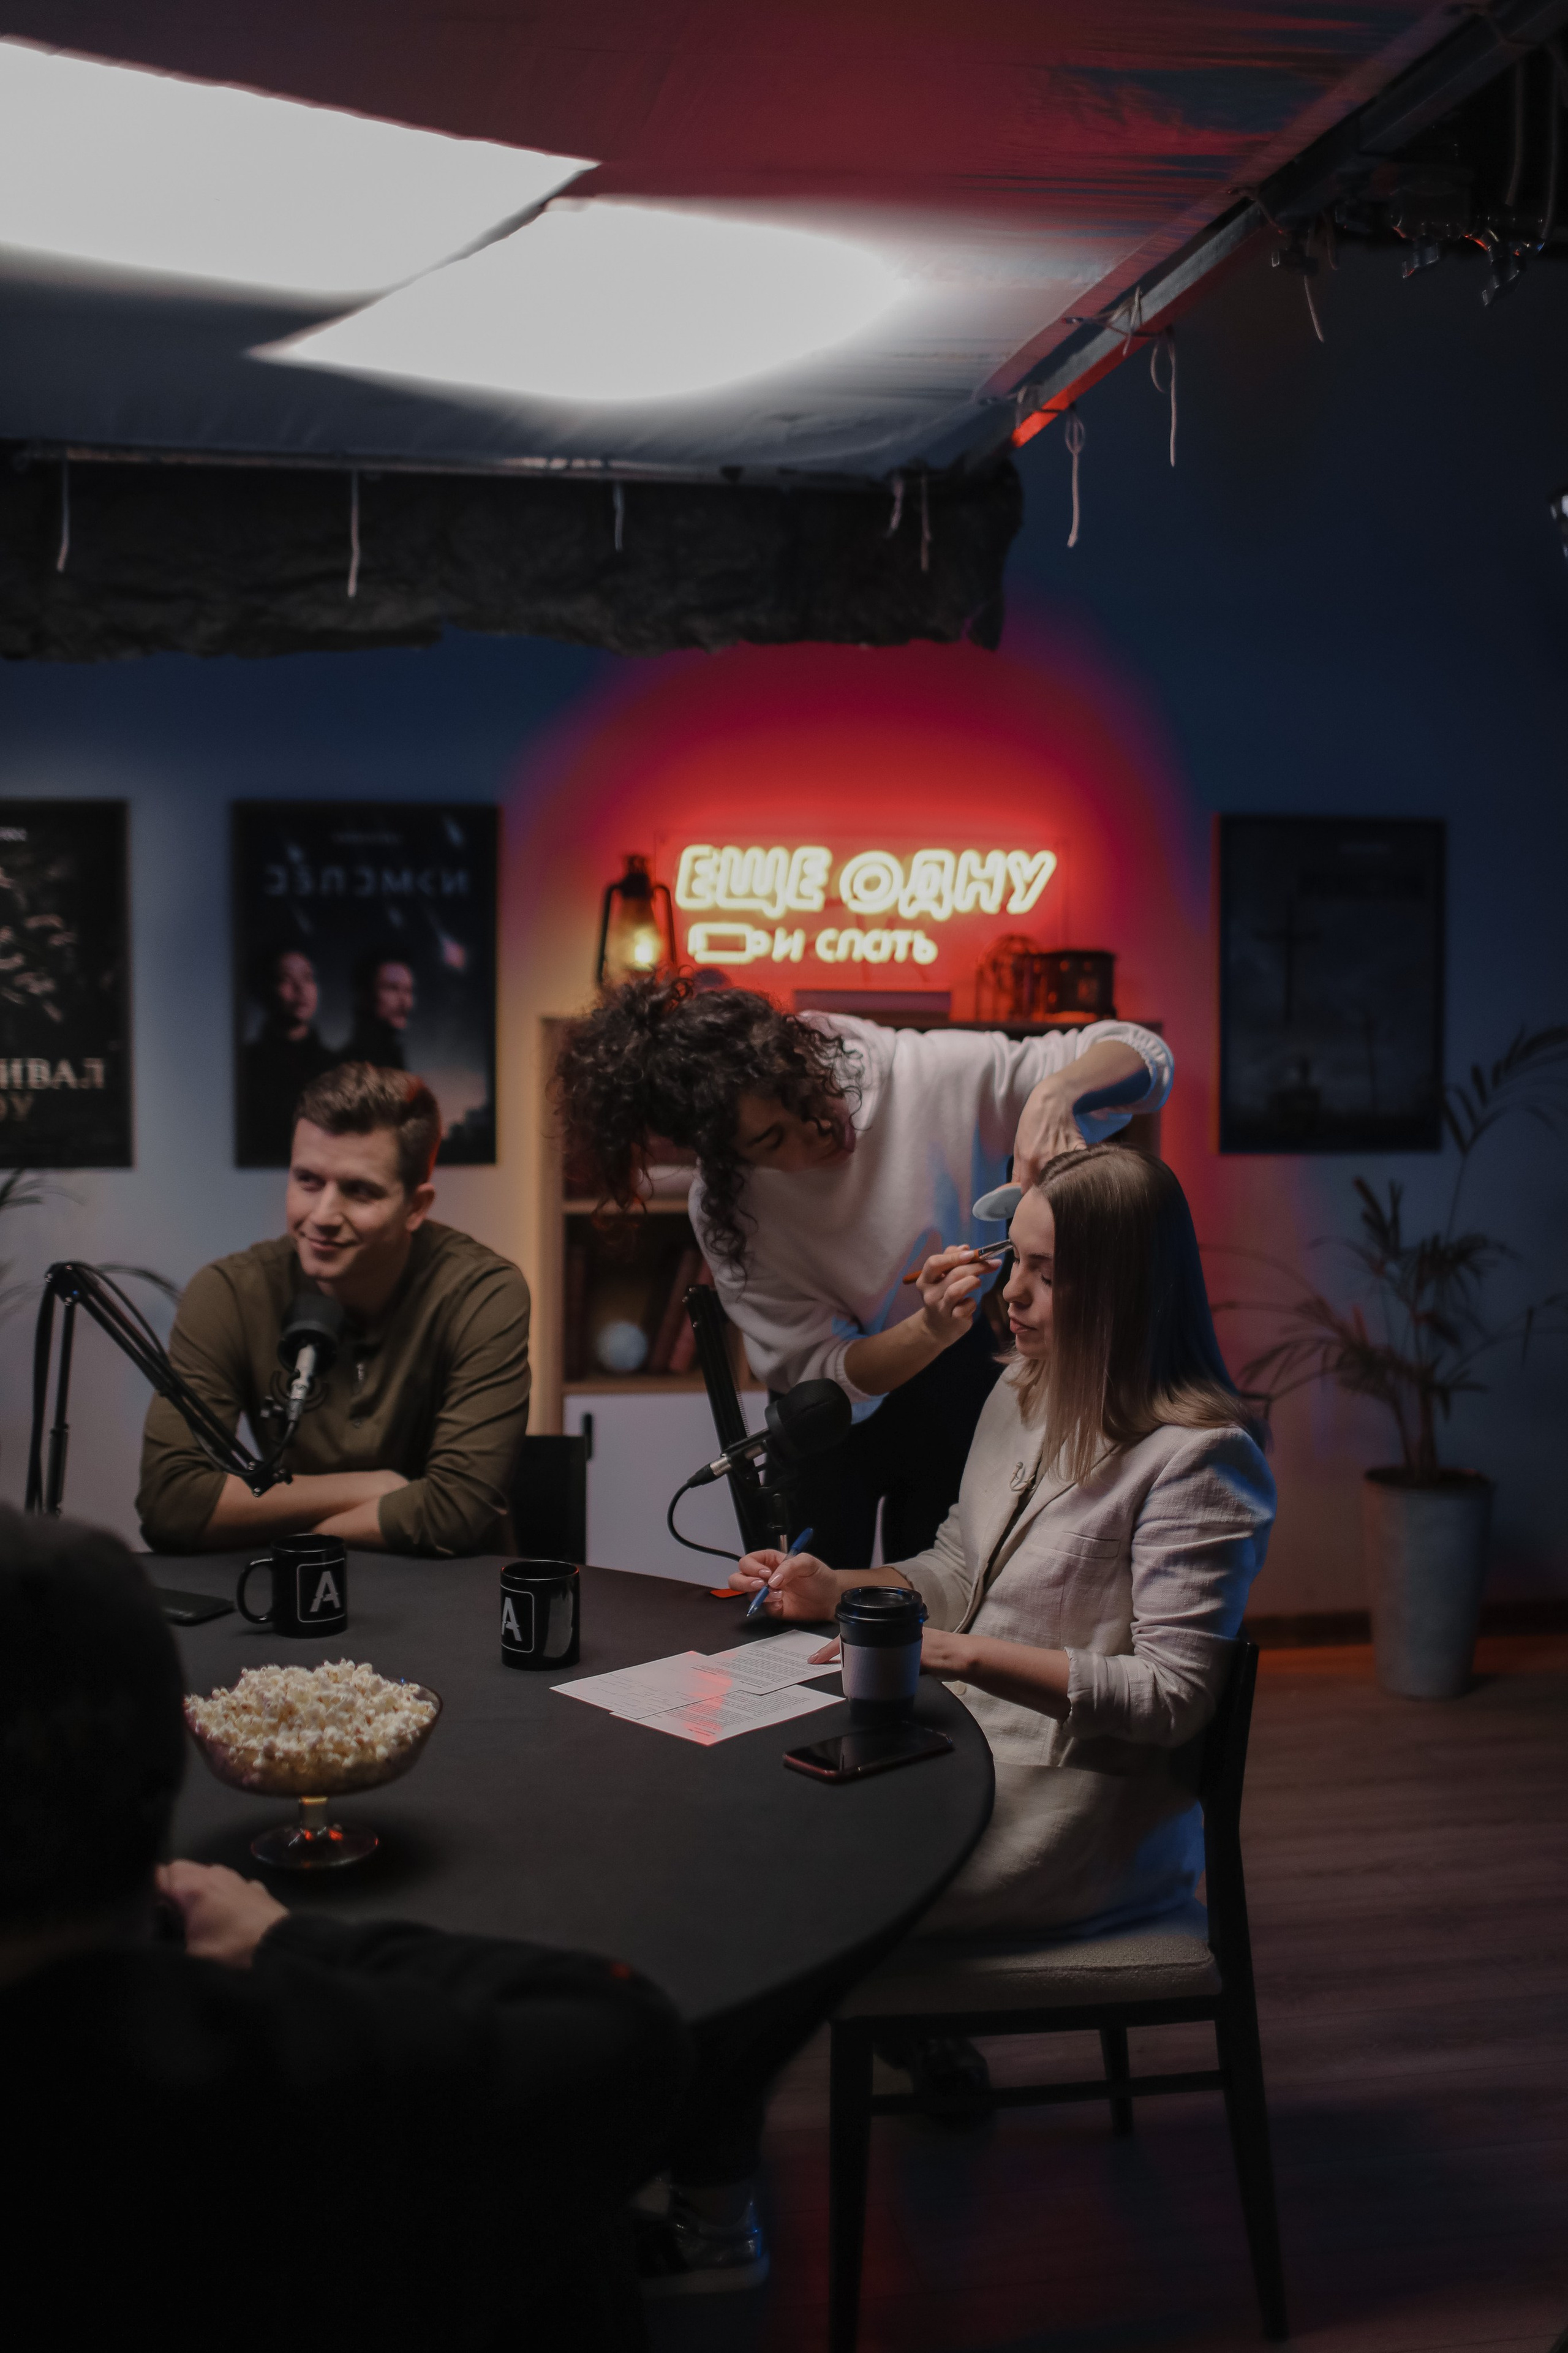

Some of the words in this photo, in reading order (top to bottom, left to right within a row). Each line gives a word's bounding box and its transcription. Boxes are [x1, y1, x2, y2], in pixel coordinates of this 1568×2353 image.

[676, 845, 833, 919] ЕЩЕ
[839, 849, 1058, 921] ОДНУ
[310, 1571, 341, 1612] A
